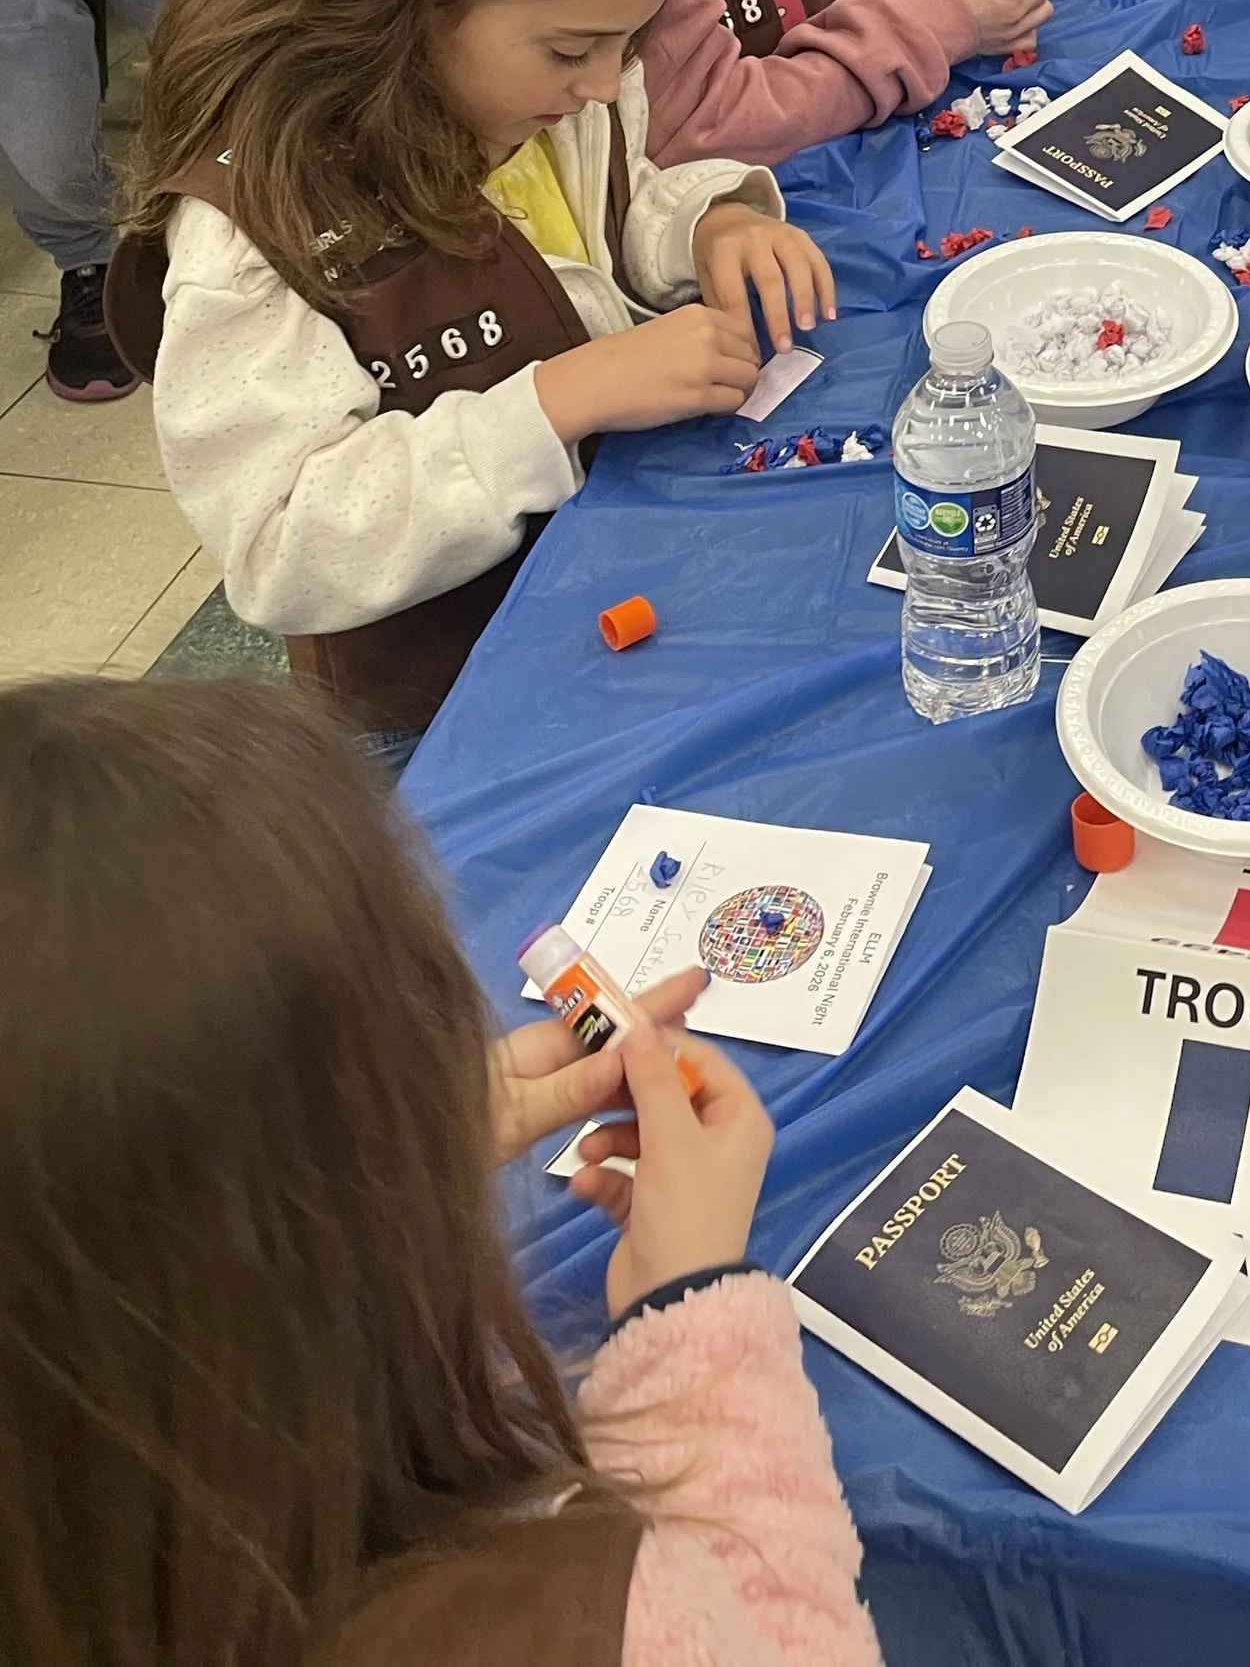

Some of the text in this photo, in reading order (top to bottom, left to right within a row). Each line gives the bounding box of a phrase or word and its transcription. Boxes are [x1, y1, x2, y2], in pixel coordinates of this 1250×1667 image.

[1043, 146, 1113, 189] PASSPORT
[371, 310, 503, 389] 2568
[1049, 496, 1084, 559] United States
[1065, 503, 1093, 556] of America
[589, 887, 616, 915] Troop
[640, 899, 667, 932] Name
[826, 898, 859, 948] February
[812, 873, 889, 1026] Brownie International Night
[859, 932, 882, 964] ELLM
[808, 963, 829, 992] 2026
[854, 1151, 967, 1271] PASSPORT
[1024, 1268, 1095, 1349] United States
[1048, 1283, 1105, 1352] of America
